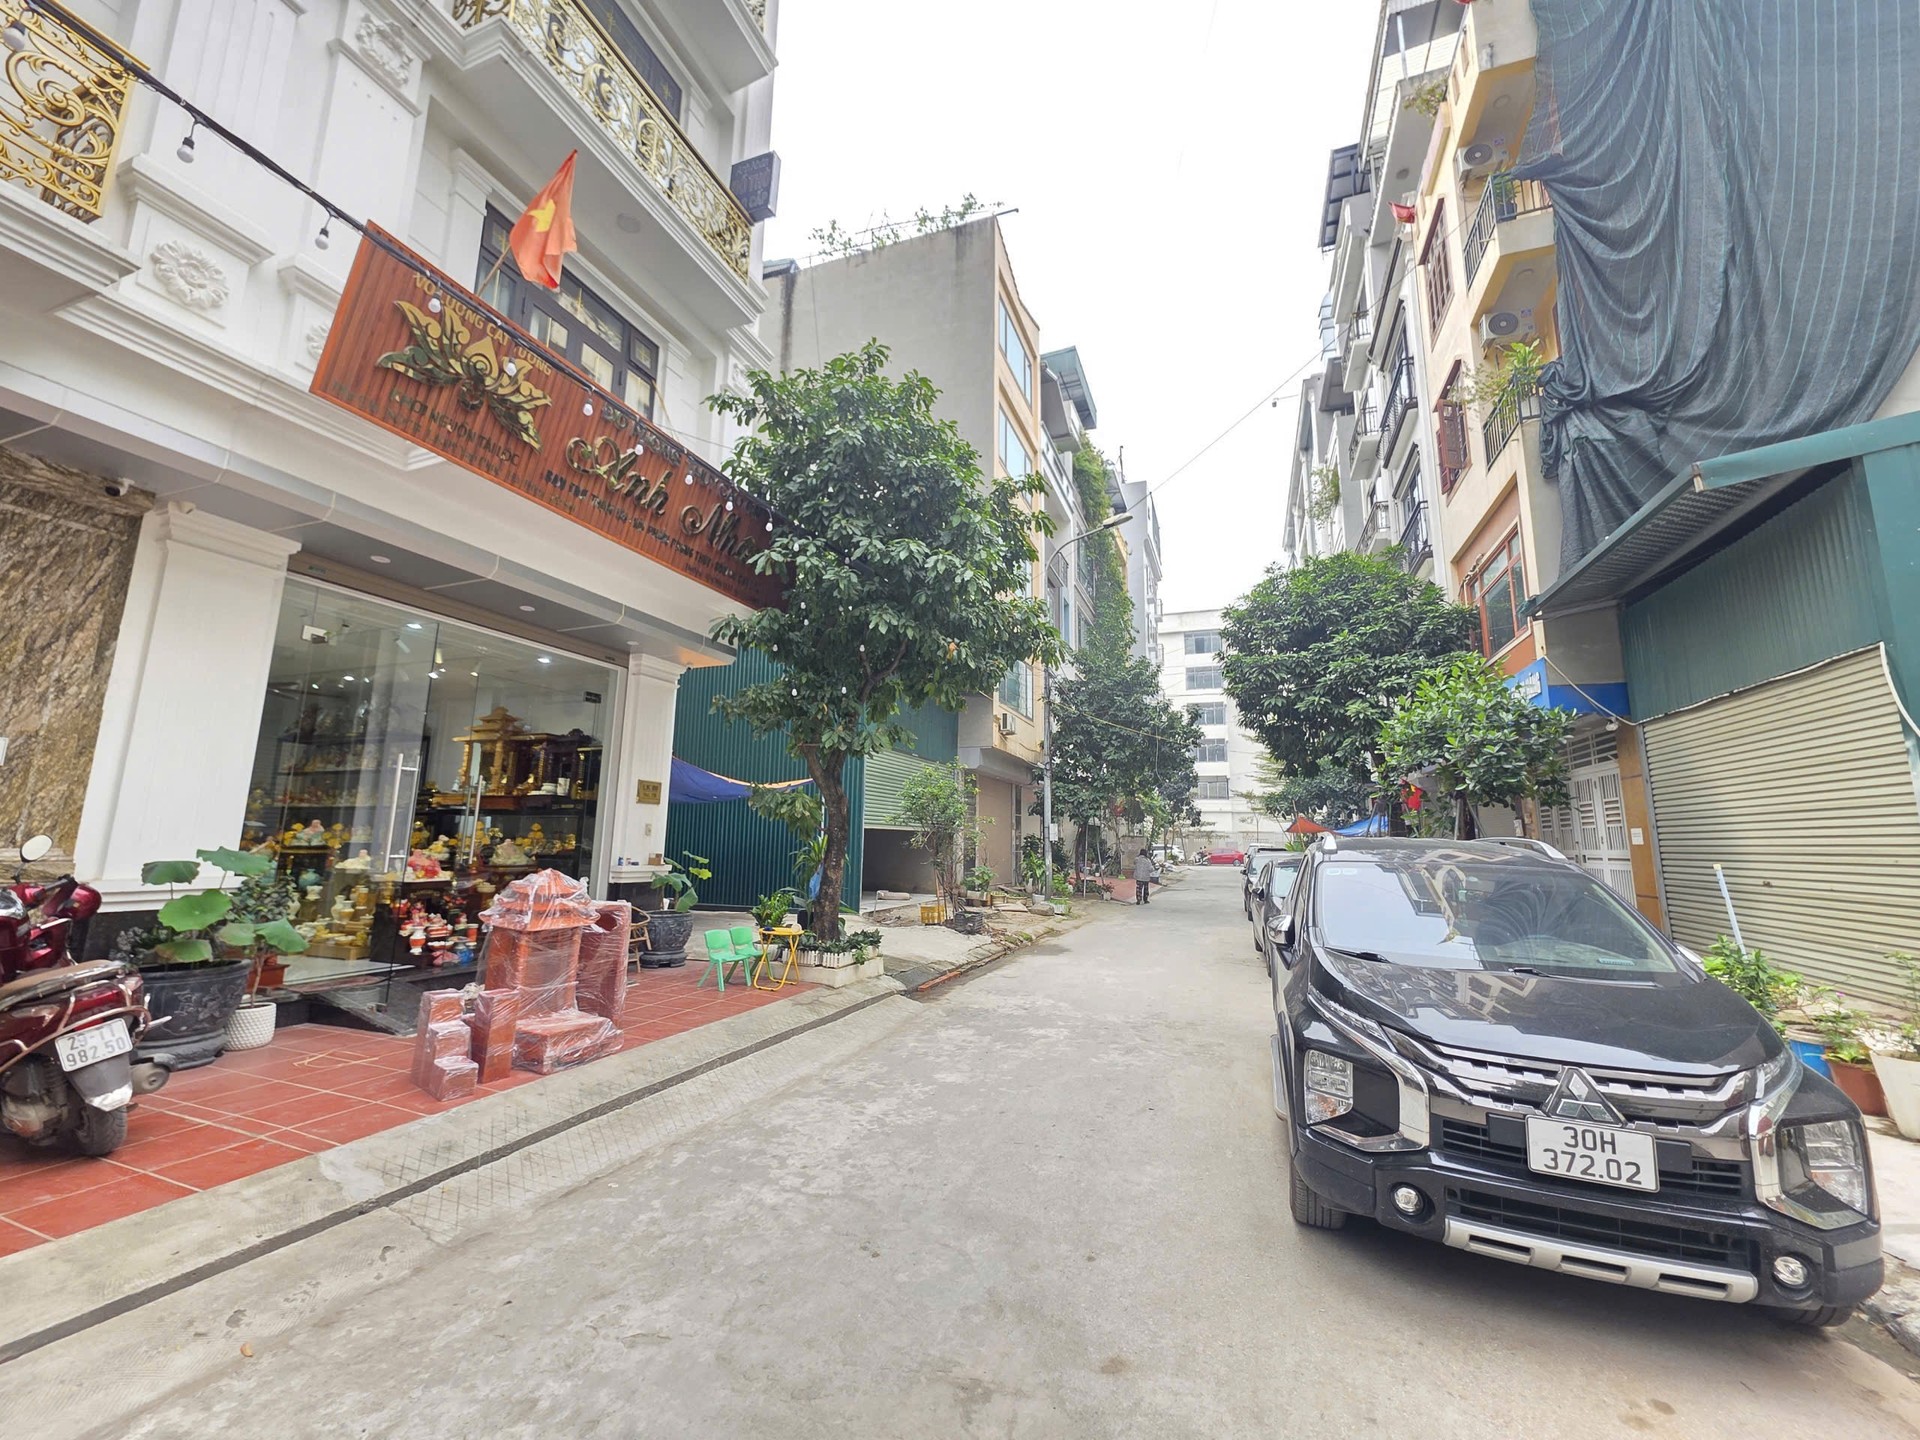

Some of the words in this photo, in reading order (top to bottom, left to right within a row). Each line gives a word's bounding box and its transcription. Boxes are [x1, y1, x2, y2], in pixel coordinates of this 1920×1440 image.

[565, 434, 673, 516] Anh
[66, 1036, 126, 1067] 982.50
[1563, 1126, 1617, 1155] 30H
[1543, 1148, 1642, 1185] 372.02
